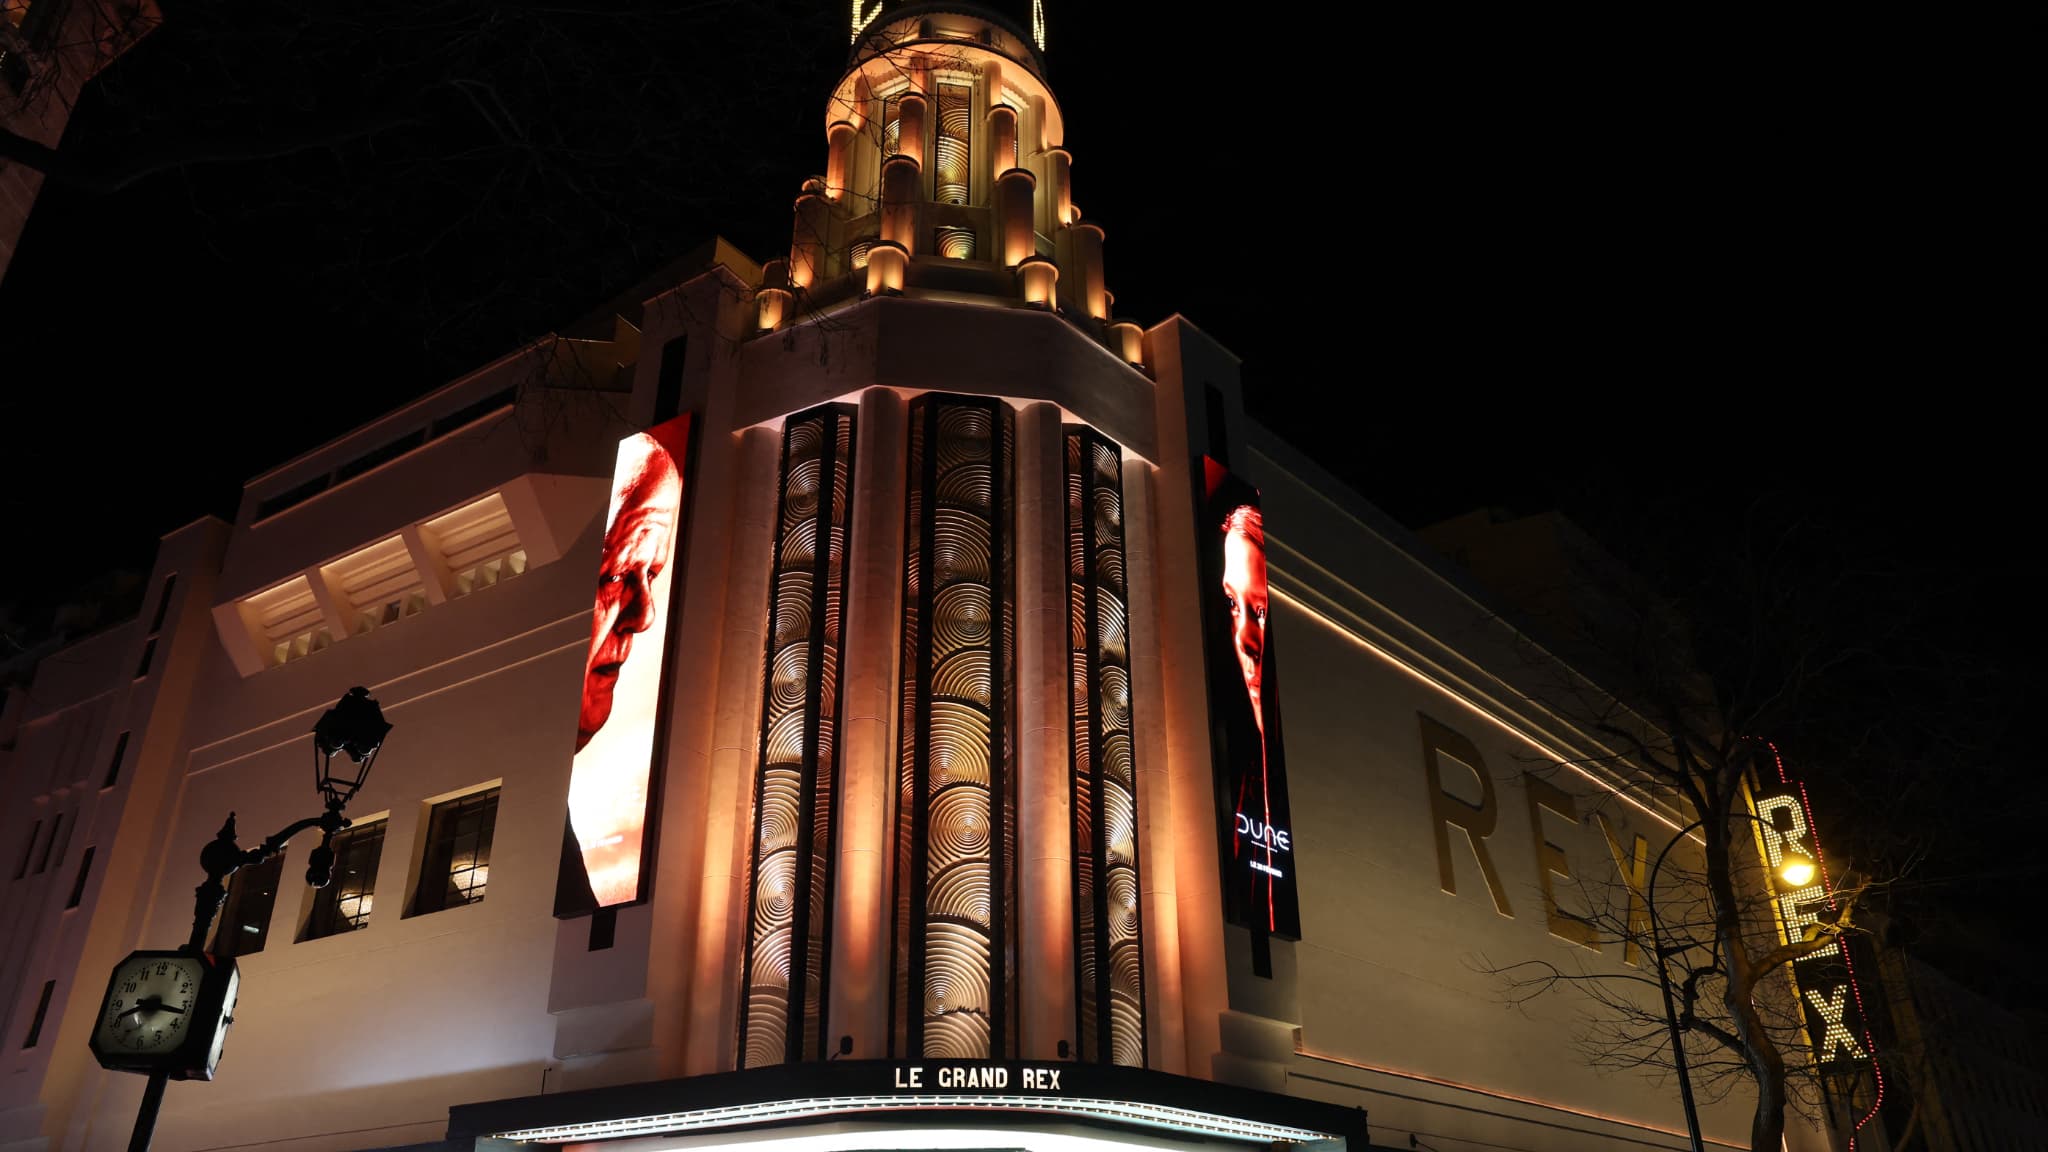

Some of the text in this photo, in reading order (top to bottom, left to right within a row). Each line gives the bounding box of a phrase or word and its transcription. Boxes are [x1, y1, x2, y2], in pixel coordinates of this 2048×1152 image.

[1235, 812, 1290, 852] DUNE
[1416, 710, 1675, 986] REX
[1757, 795, 1868, 1063] REX
[140, 970, 150, 981] 11
[156, 964, 168, 976] 12
[125, 982, 137, 993] 10
[180, 982, 188, 993] 2
[115, 999, 123, 1010] 9
[170, 1017, 178, 1029] 4
[154, 1030, 162, 1042] 5
[895, 1067, 1062, 1090] LE GRAND REX
